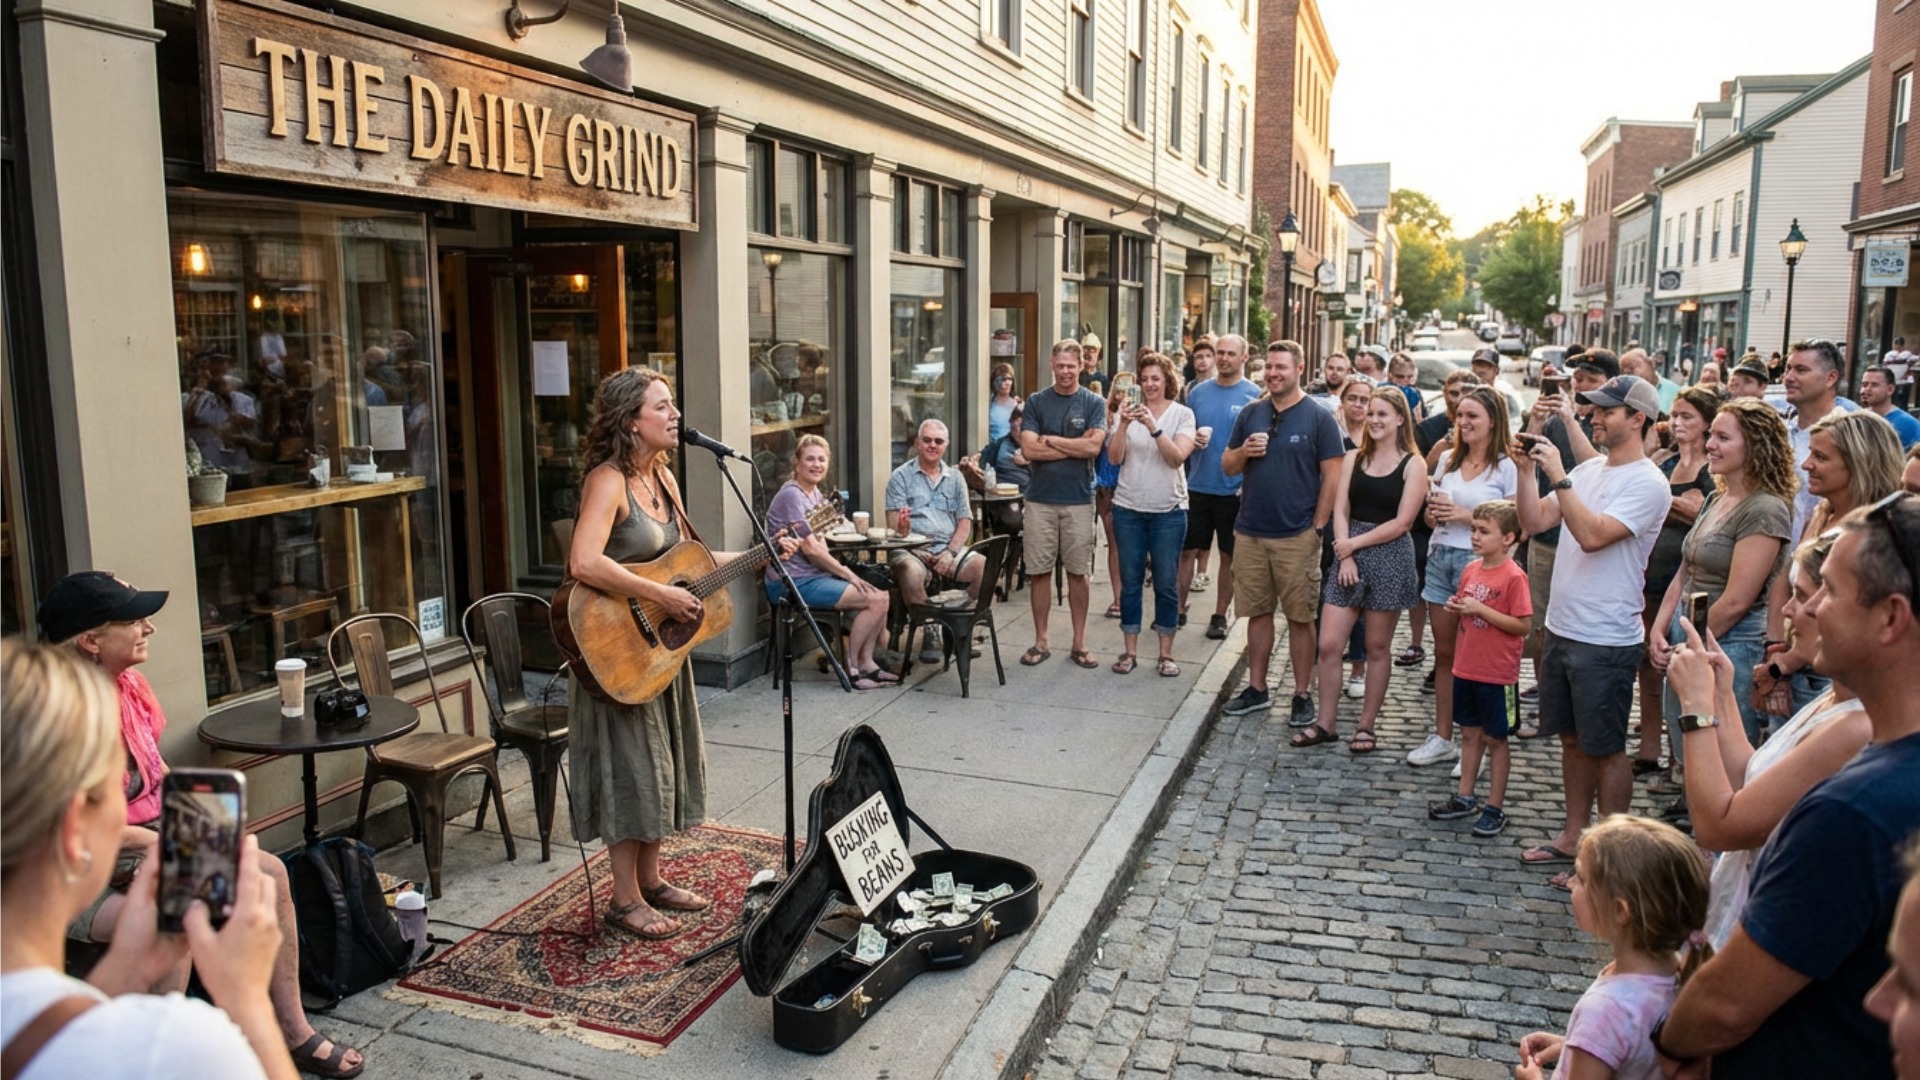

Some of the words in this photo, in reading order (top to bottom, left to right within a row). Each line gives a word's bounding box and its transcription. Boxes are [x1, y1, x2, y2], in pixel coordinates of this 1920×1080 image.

[254, 37, 390, 153] THE
[408, 74, 552, 179] DAILY
[566, 113, 683, 199] GRIND
[833, 799, 889, 860] BUSKING
[858, 848, 904, 903] BEANS
